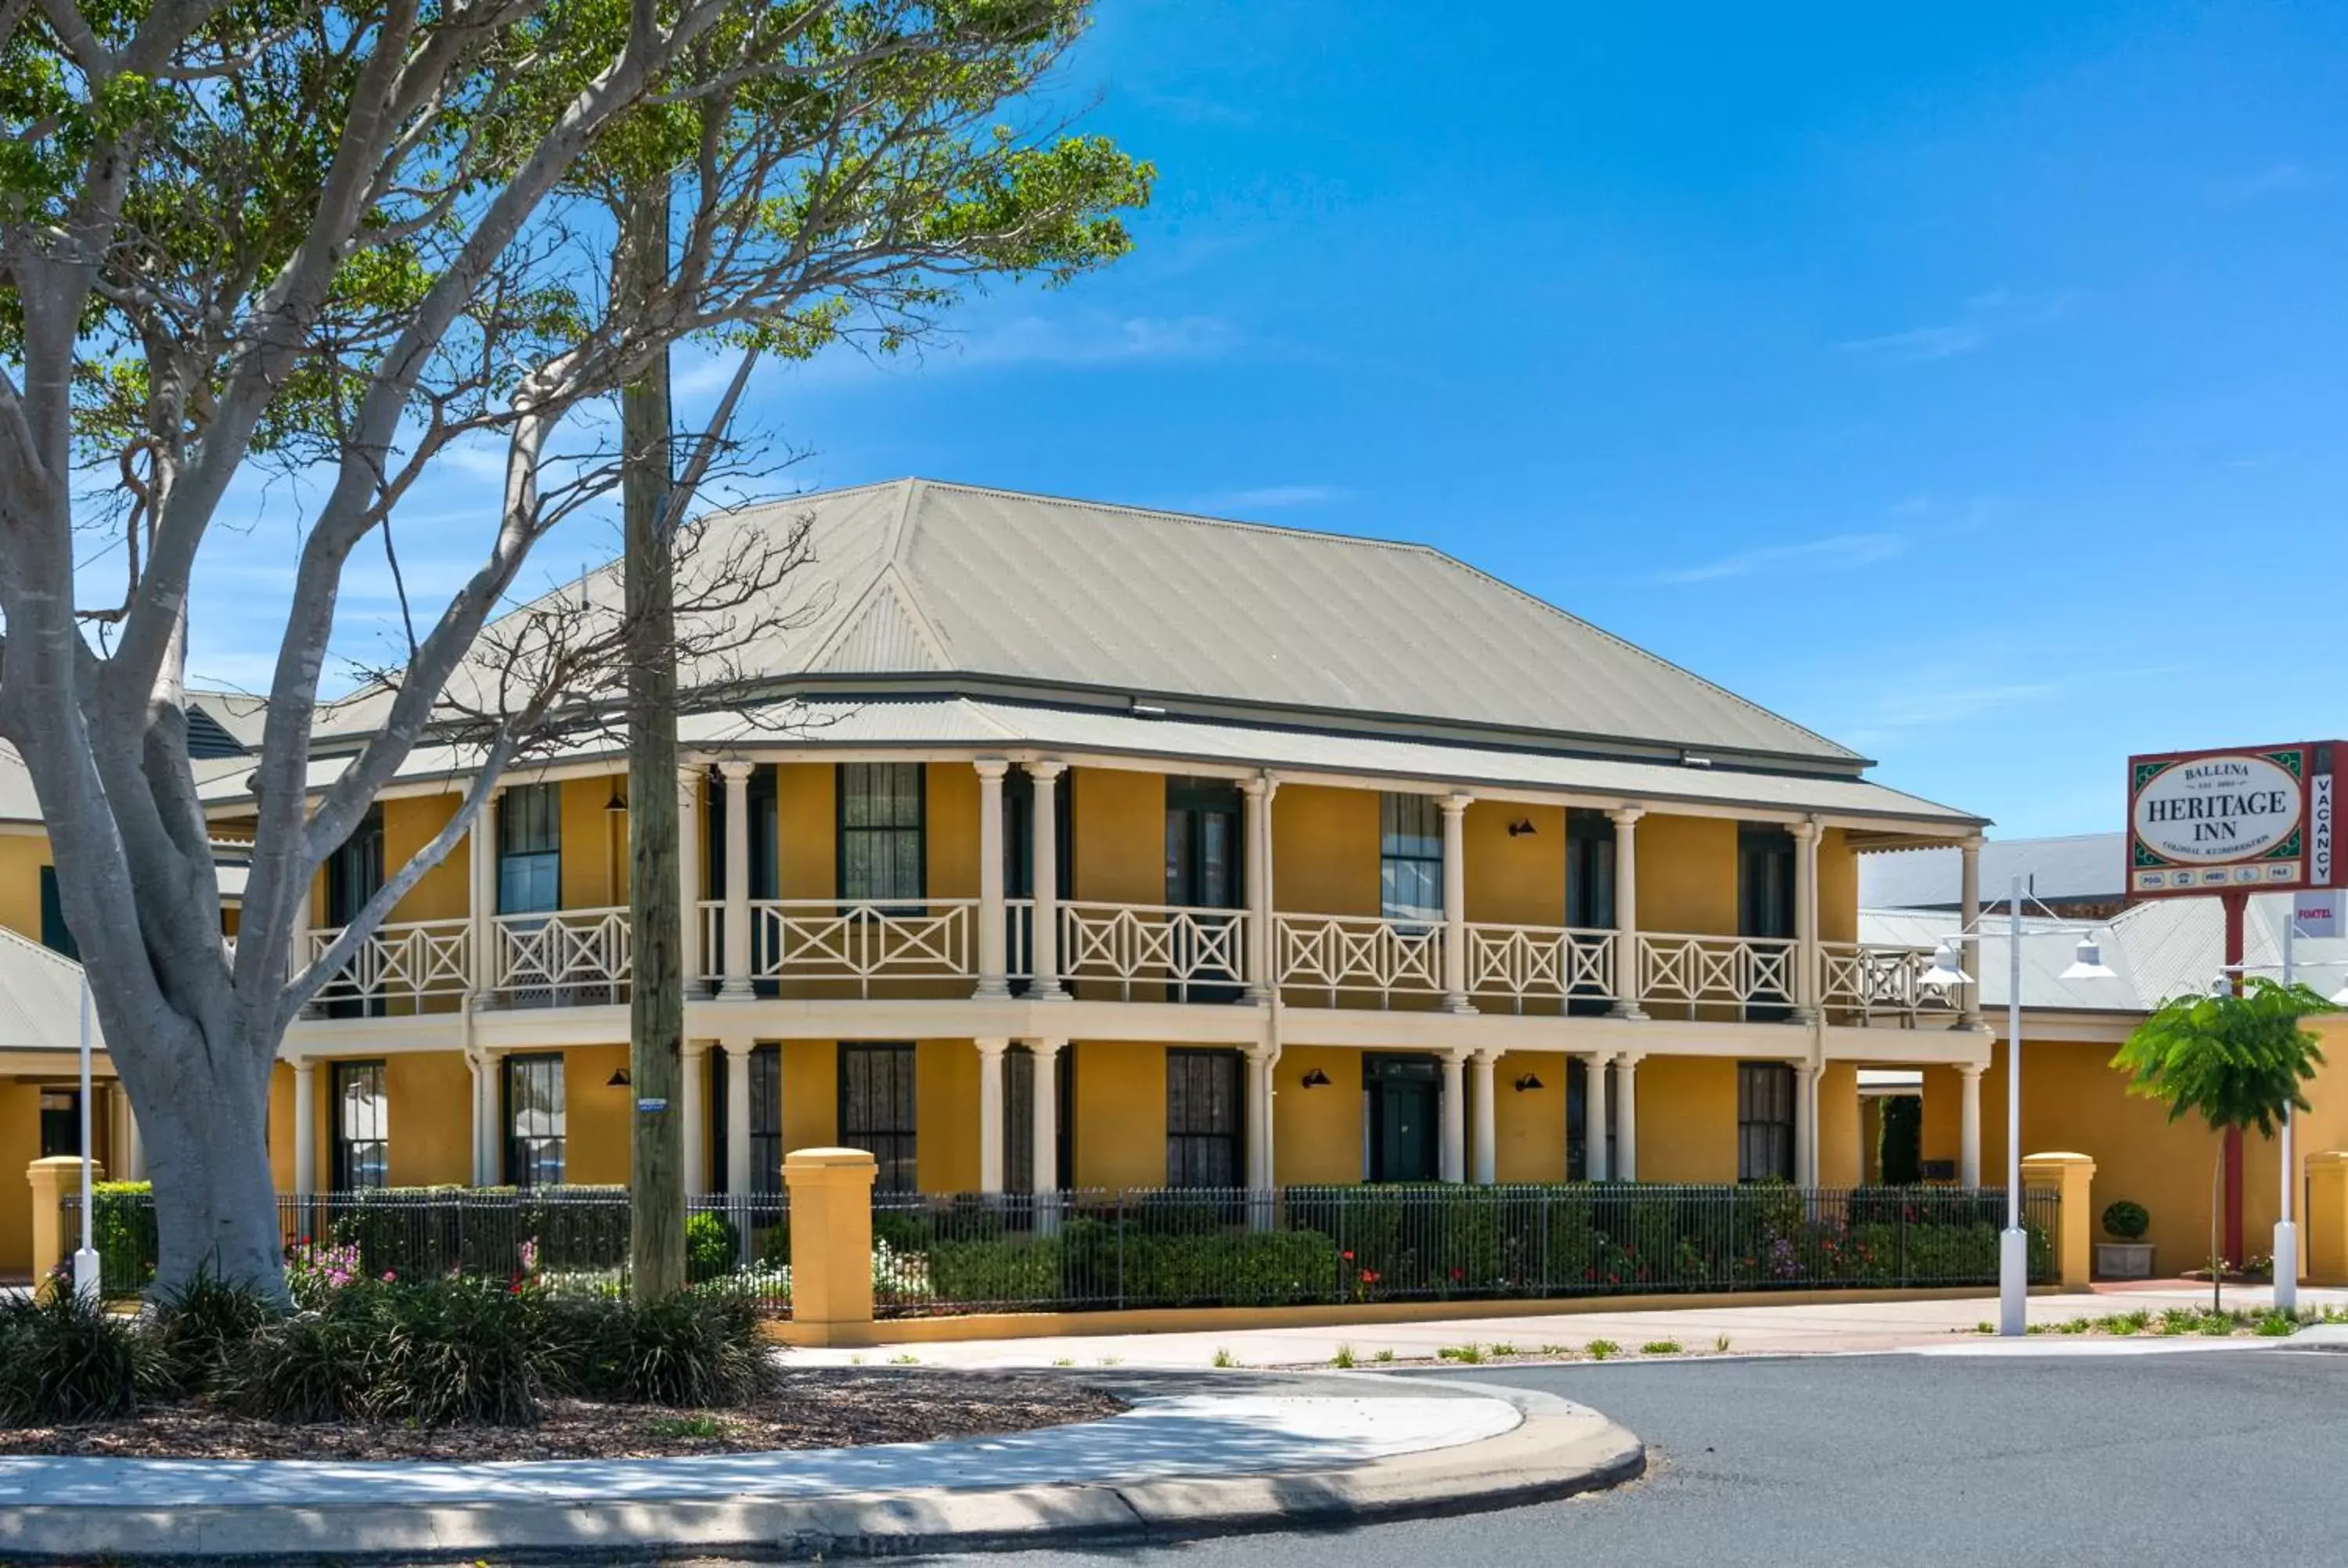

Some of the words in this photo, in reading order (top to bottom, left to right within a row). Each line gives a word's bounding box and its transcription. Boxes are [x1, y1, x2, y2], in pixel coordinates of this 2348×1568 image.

[2184, 763, 2249, 780] BALLINA
[2147, 790, 2286, 822] HERITAGE
[2194, 821, 2236, 841] INN
[2317, 780, 2332, 879] VACANCY
